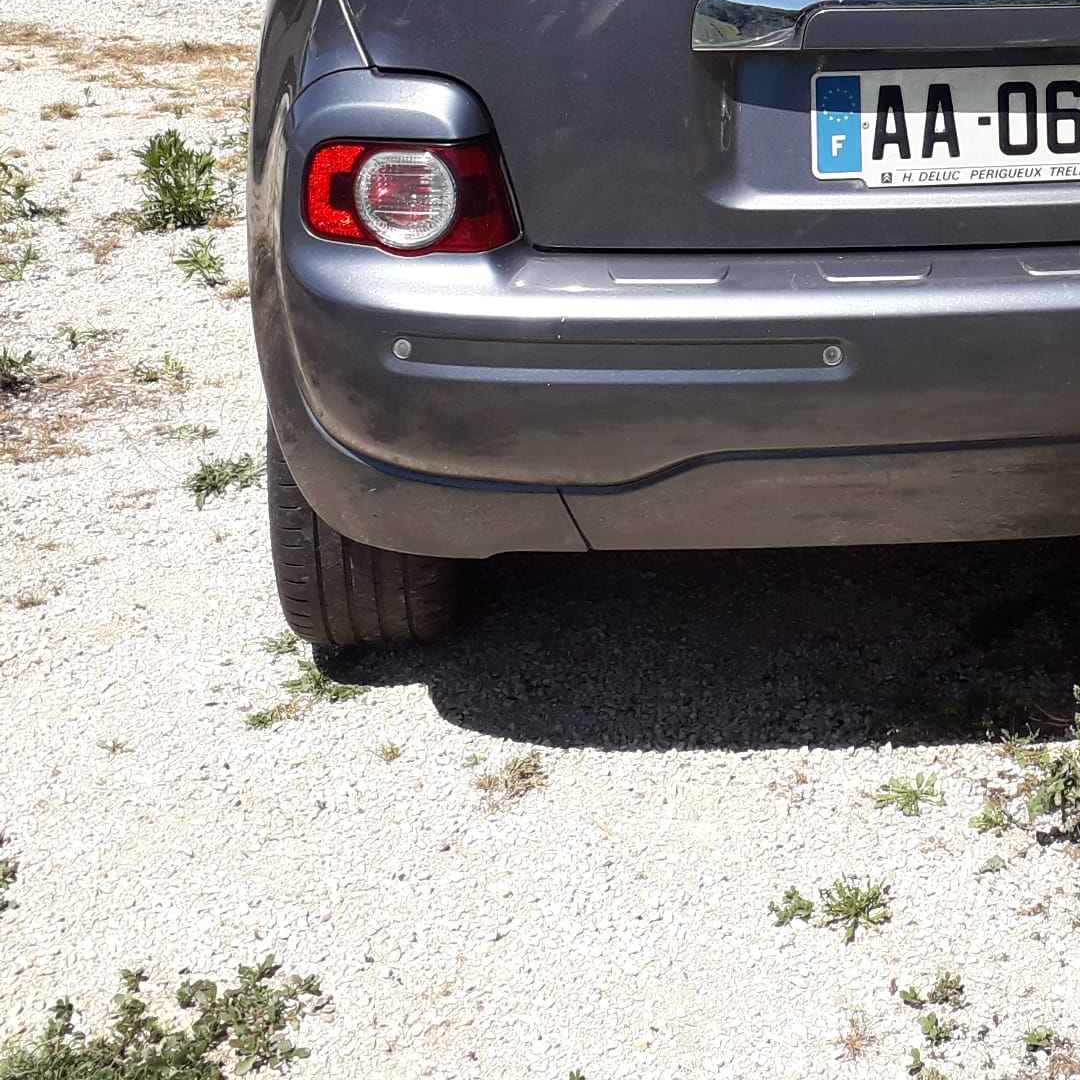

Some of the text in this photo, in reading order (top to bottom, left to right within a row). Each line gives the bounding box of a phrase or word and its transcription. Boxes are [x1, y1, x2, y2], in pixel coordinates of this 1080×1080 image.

[831, 134, 846, 157] F
[902, 172, 915, 182] H.
[918, 171, 961, 182] DELUC
[970, 167, 1042, 180] PERIGUEUX
